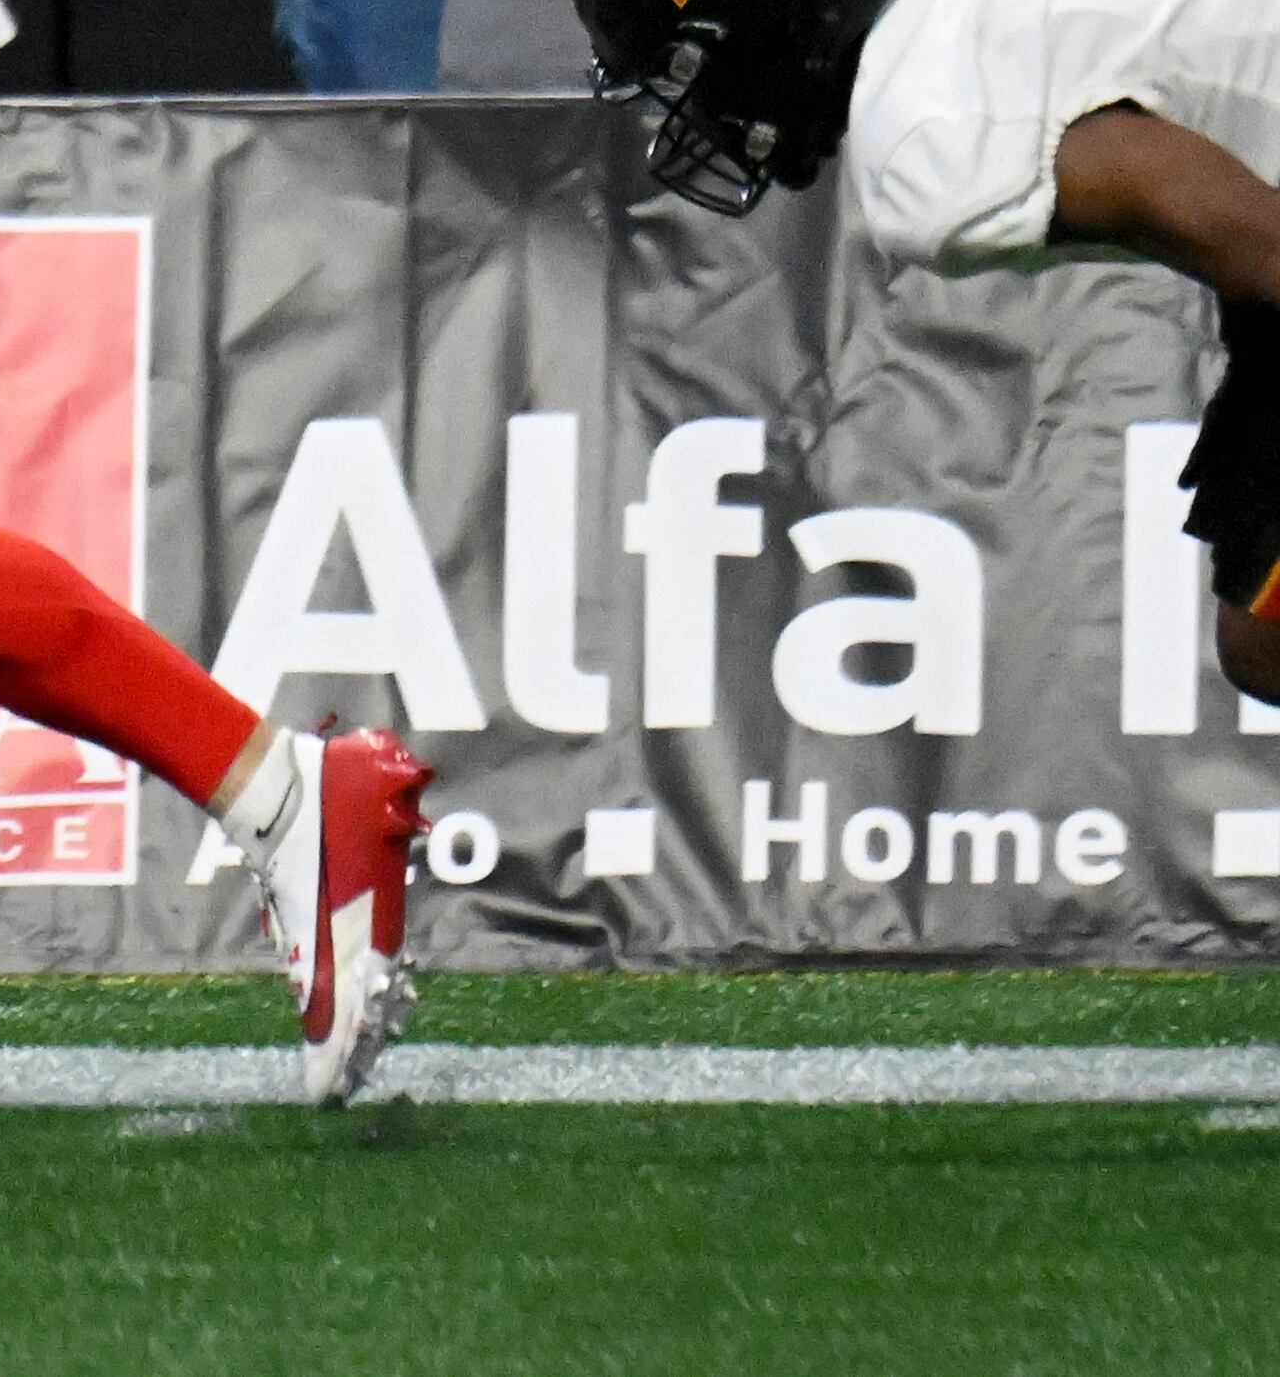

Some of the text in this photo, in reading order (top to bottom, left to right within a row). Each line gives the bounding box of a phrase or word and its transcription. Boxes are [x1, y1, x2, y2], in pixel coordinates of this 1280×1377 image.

[210, 412, 1280, 737] Alfa I
[741, 779, 1128, 886] Home
